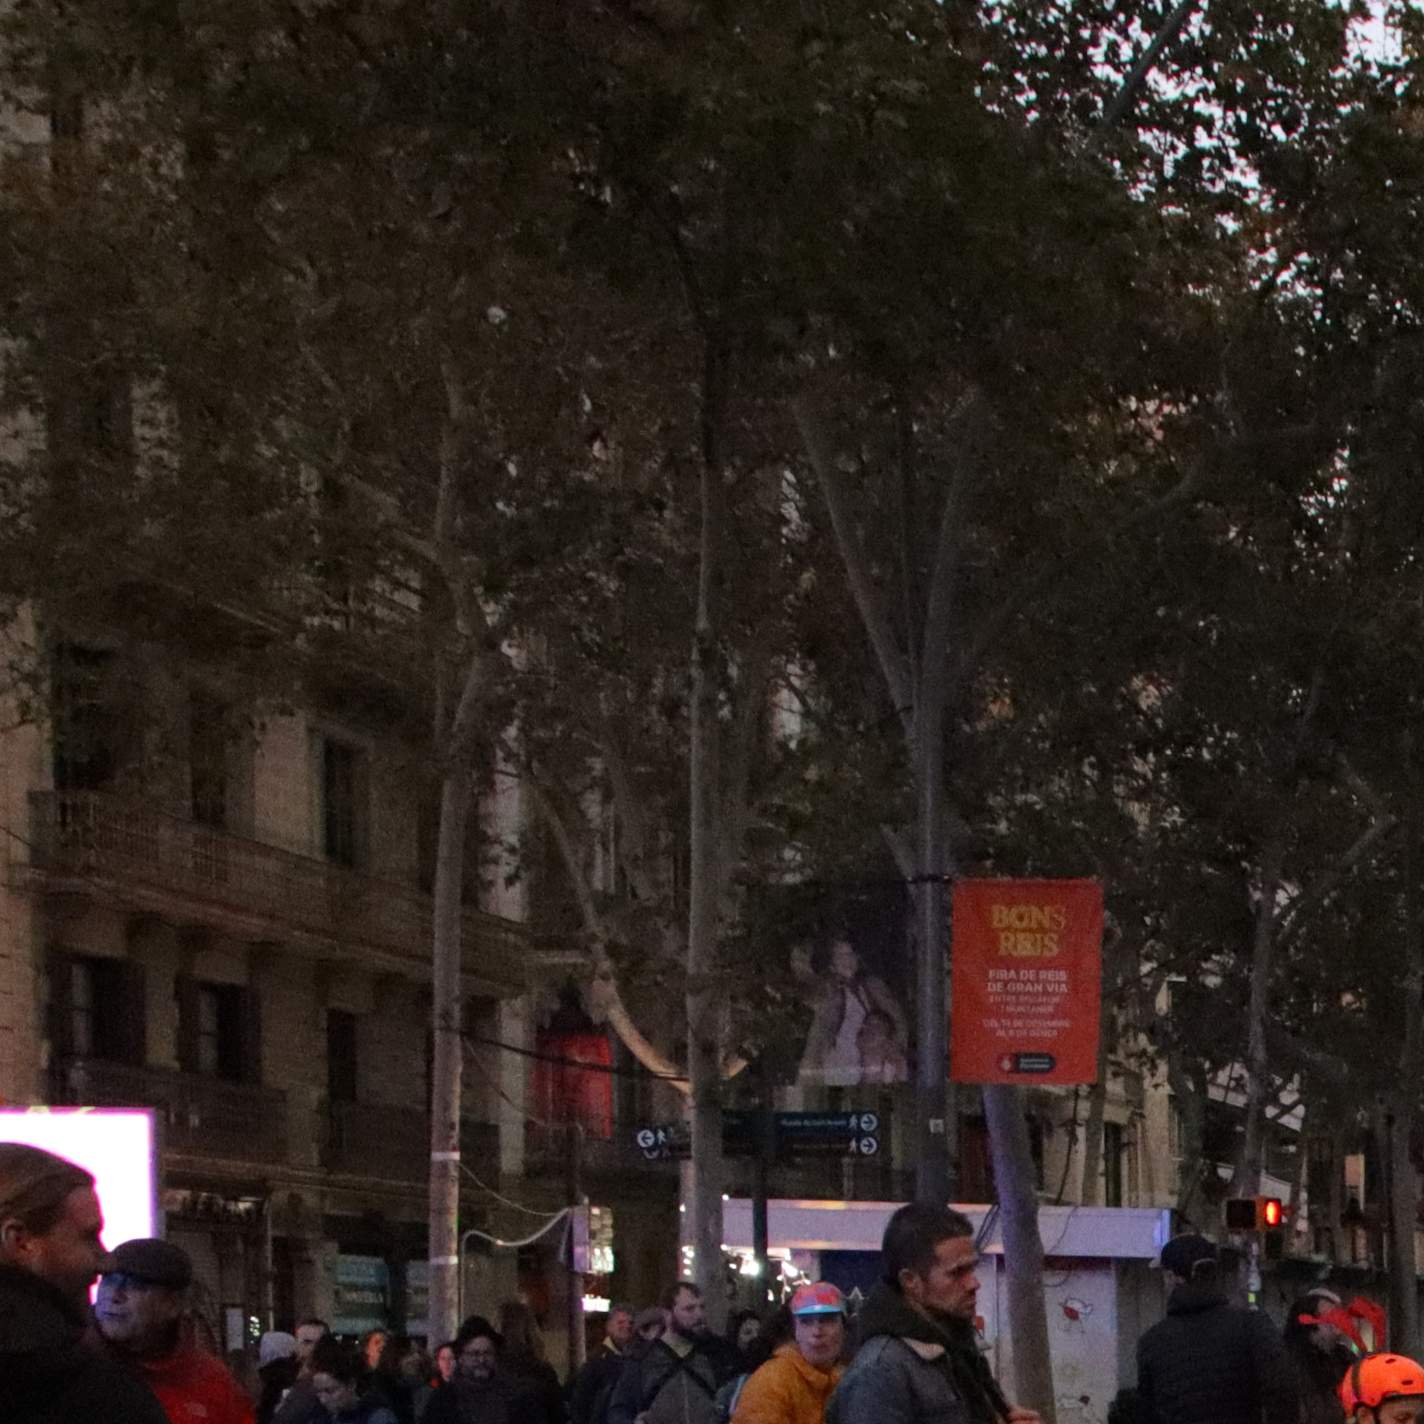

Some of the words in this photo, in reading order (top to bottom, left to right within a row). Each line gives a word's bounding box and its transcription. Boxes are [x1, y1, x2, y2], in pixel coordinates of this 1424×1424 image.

[991, 904, 1067, 930] BONS
[998, 932, 1060, 957] REIS
[988, 969, 1017, 981] FIRA
[1020, 969, 1036, 981] DE
[987, 981, 1004, 993] DE
[1006, 981, 1043, 993] GRAN
[1046, 981, 1069, 993] VIA
